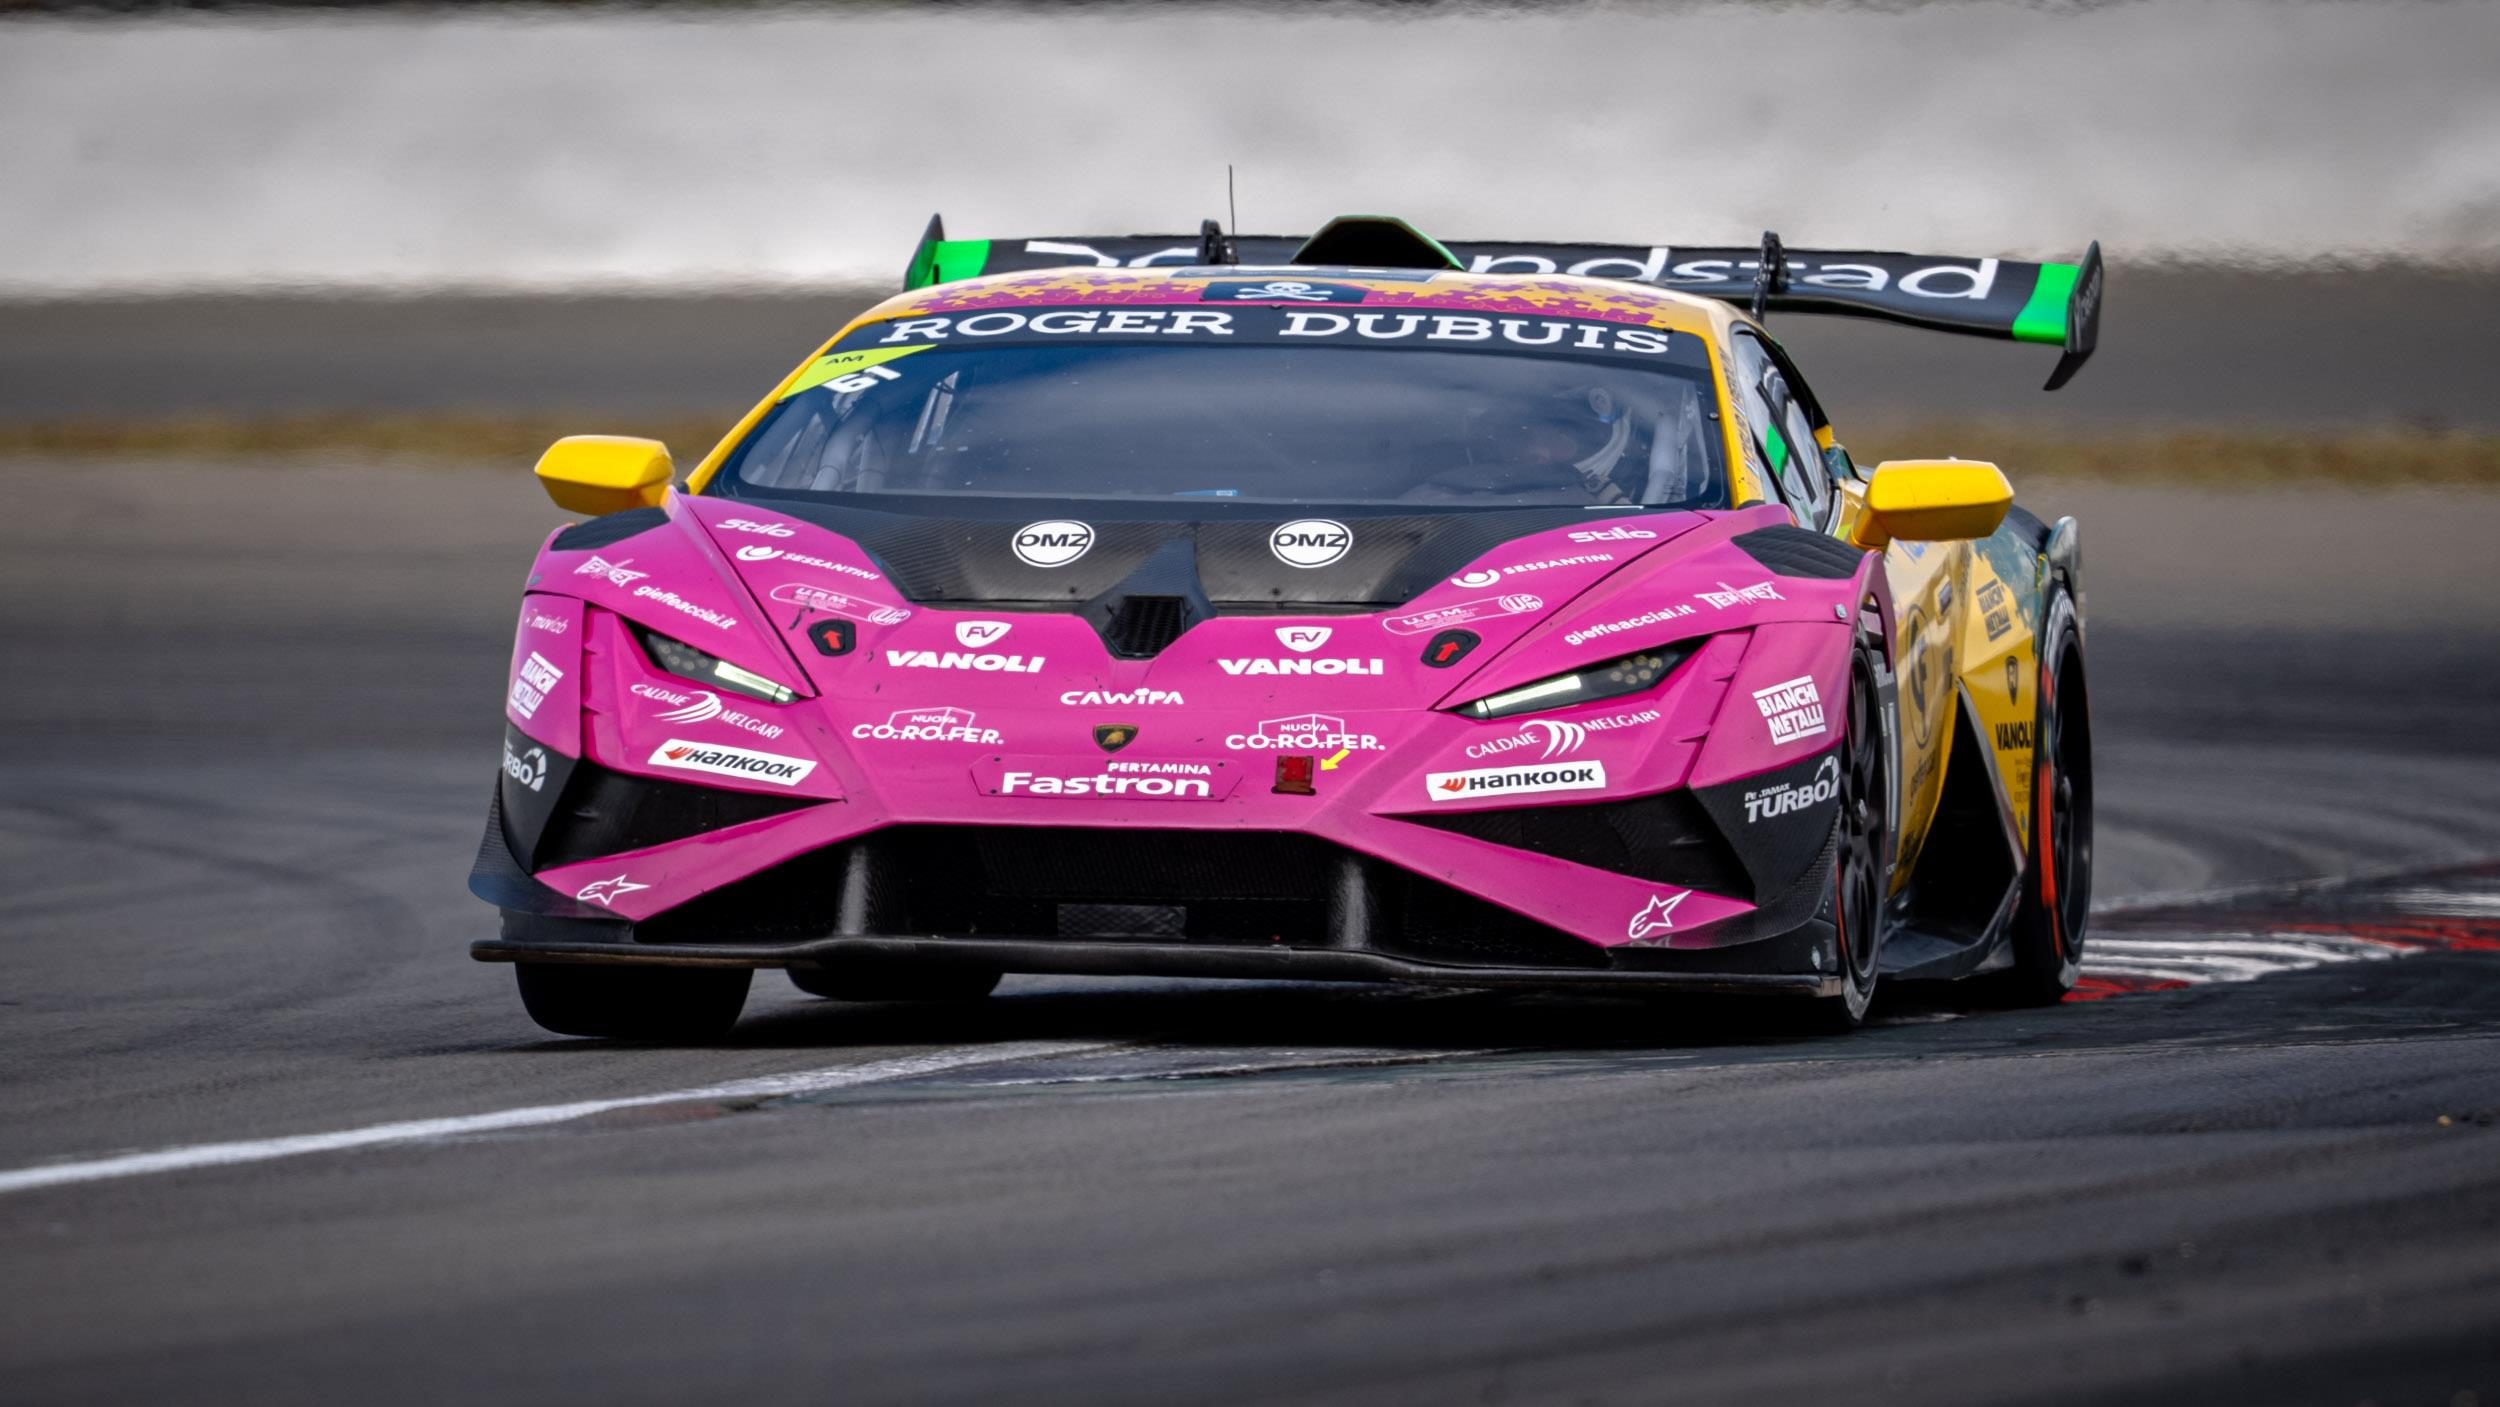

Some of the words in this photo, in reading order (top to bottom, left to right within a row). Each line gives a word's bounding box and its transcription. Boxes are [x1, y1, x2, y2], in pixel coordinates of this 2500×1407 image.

[879, 310, 1234, 343] ROGER
[1279, 312, 1669, 354] DUBUIS
[825, 355, 864, 366] AM
[716, 519, 795, 538] Stilo
[1568, 527, 1657, 543] Stilo
[1018, 534, 1090, 548] OMZ
[1274, 533, 1349, 548] OMZ
[782, 552, 880, 581] SESSANTINI
[1503, 553, 1614, 575] SESSANTINI
[966, 626, 999, 638] FV
[1564, 604, 1697, 646] gieffeacciai.it
[1291, 631, 1321, 642] FV
[886, 650, 1046, 673] VANOLI
[1217, 658, 1384, 676] VANOLI
[630, 684, 691, 707] CALDAIE
[718, 709, 784, 740] MELGARI
[911, 714, 958, 724] NUOVA
[1280, 723, 1329, 732] NUOVA
[1466, 731, 1541, 759] CALDAIE
[1584, 710, 1661, 732] MELGARI
[1107, 761, 1211, 776] PERTAMINA
[1002, 771, 1210, 797] Fastron
[1744, 779, 1830, 823] TURBO
